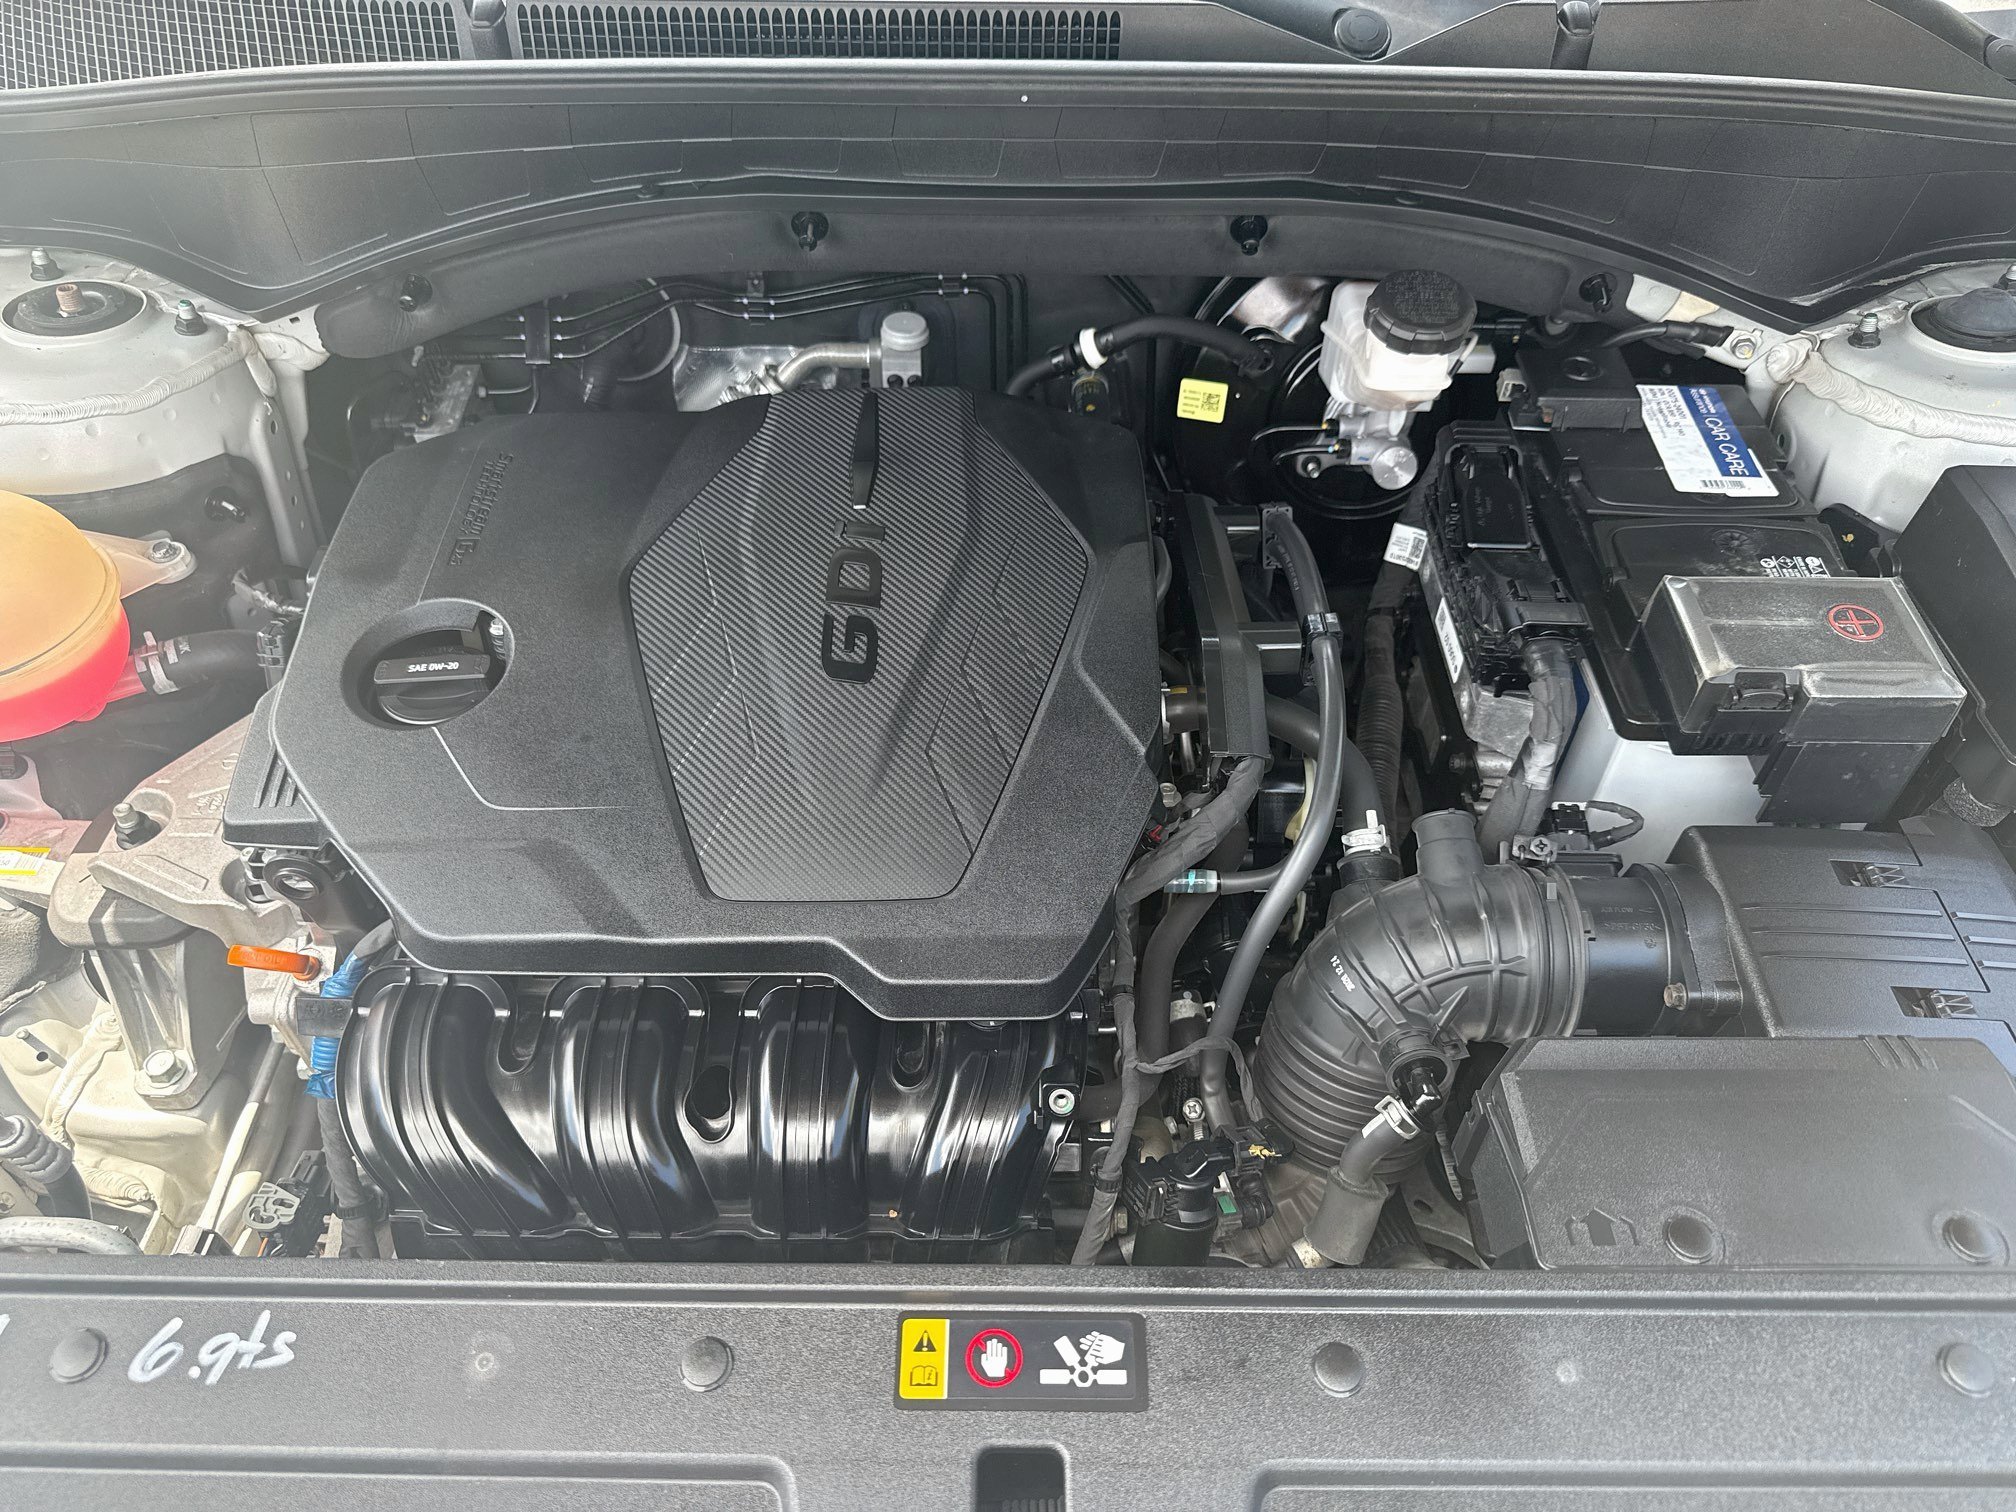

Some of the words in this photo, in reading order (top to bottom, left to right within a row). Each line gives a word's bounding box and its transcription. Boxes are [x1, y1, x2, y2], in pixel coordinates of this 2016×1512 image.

[1705, 417, 1731, 441] CAR
[1718, 443, 1749, 476] CARE
[407, 663, 428, 673] SAE
[428, 661, 460, 671] 0W-20
